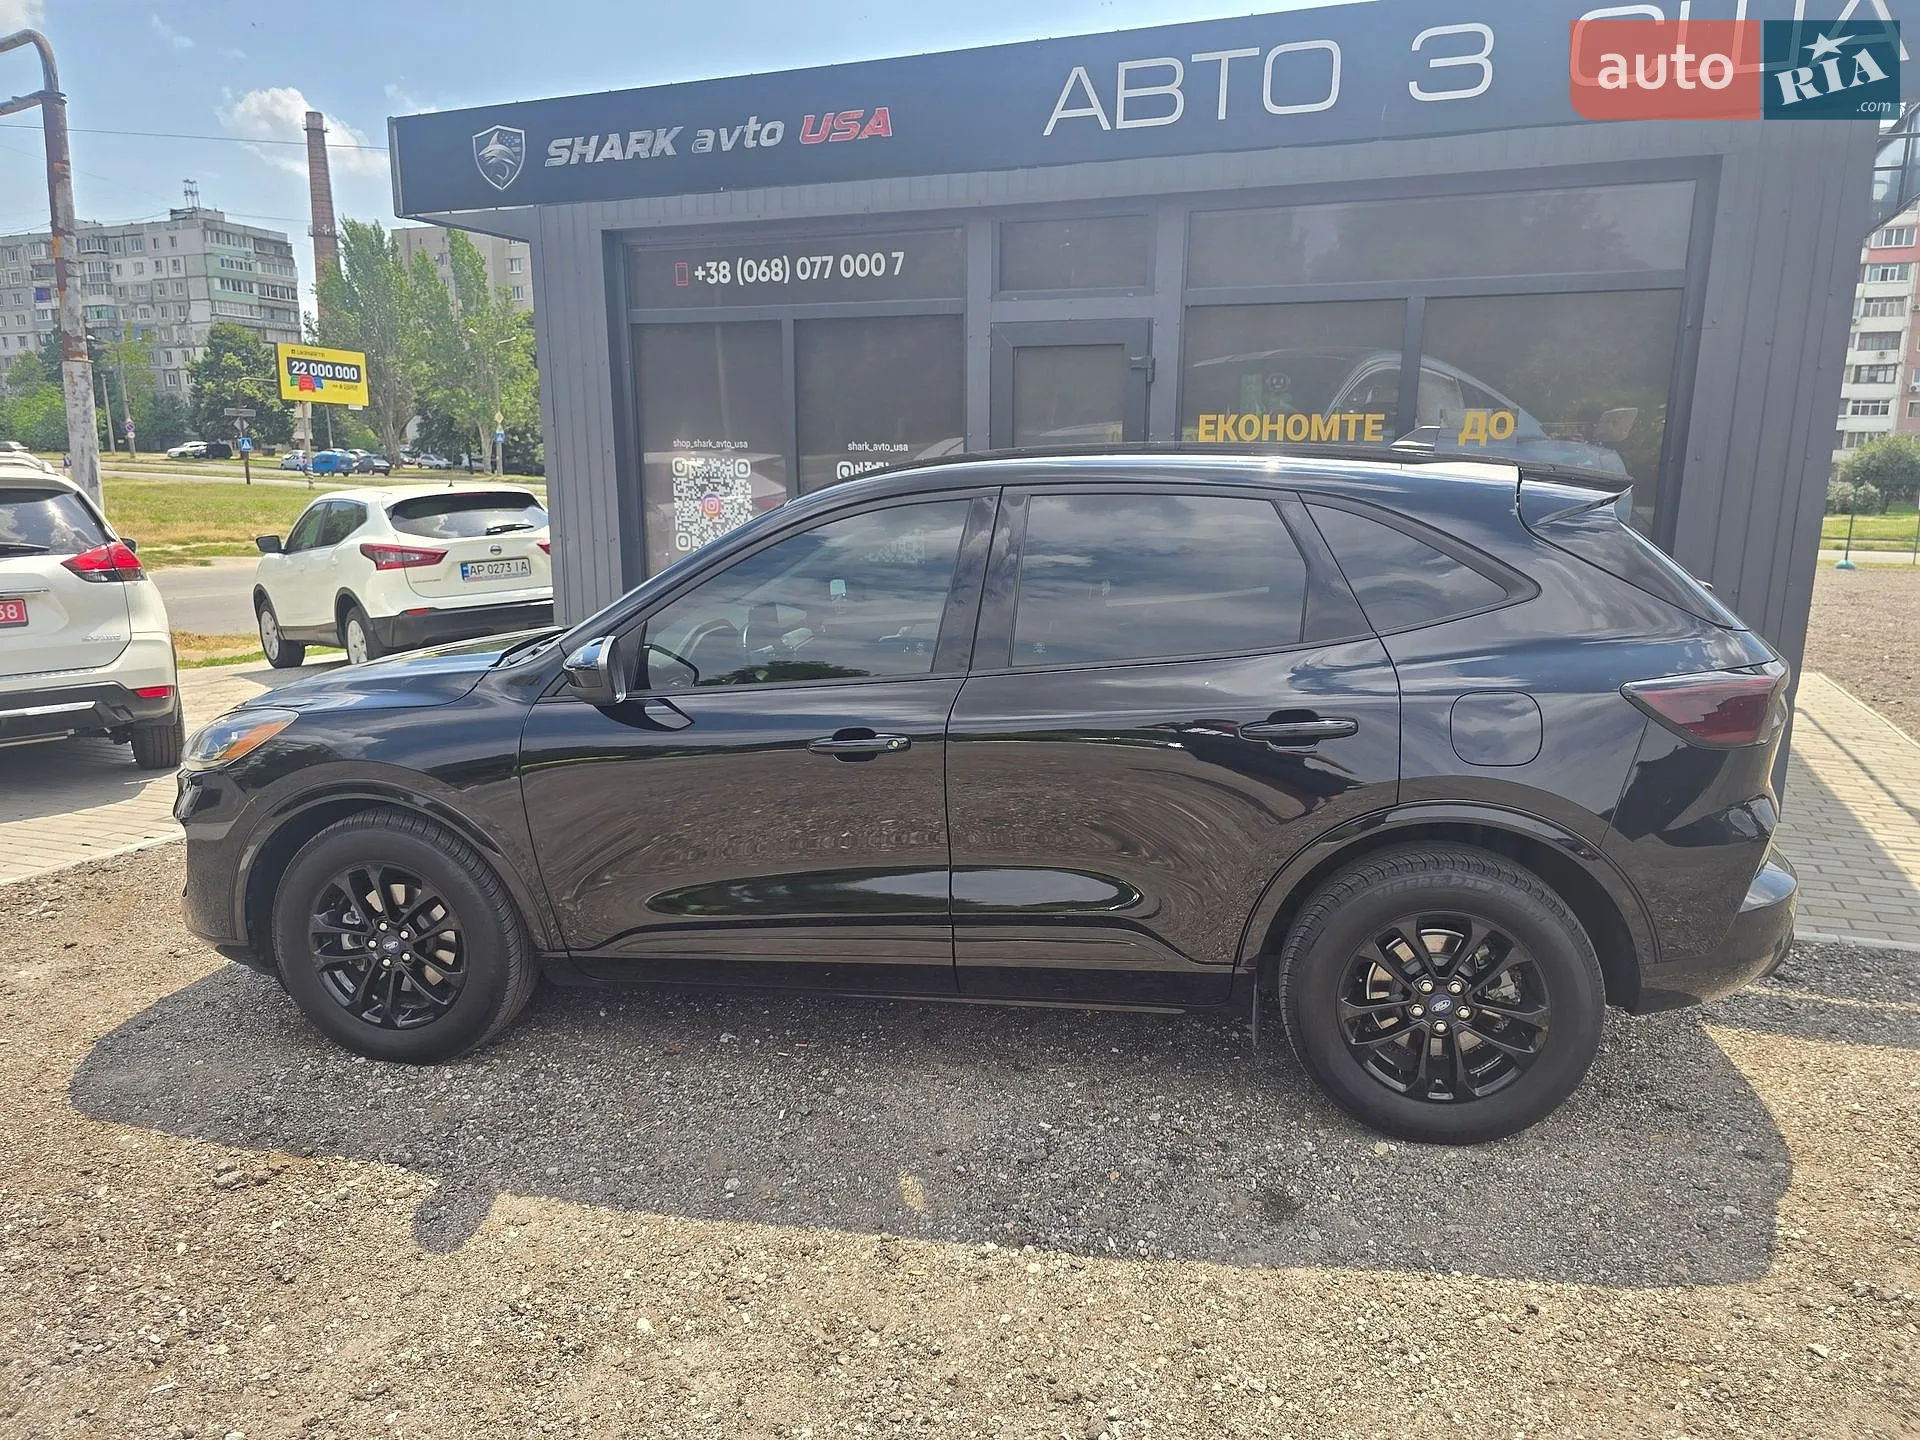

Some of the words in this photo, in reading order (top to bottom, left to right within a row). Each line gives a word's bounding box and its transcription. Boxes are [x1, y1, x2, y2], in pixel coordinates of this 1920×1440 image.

[1043, 39, 1342, 136] АВТО
[544, 126, 684, 167] SHARK
[691, 115, 785, 154] avto
[799, 107, 893, 145] USA
[694, 260, 731, 284] +38
[736, 255, 790, 285] (068)
[796, 255, 834, 280] 077
[839, 251, 886, 278] 000
[891, 251, 905, 276] 7
[291, 360, 308, 375] 22
[309, 362, 333, 378] 000
[335, 365, 358, 380] 000
[1457, 411, 1515, 447] ДО
[672, 439, 748, 449] shop_shark_avto_usa
[847, 442, 909, 452] shark_avto_usa
[470, 564, 485, 575] AP
[487, 562, 512, 575] 0273
